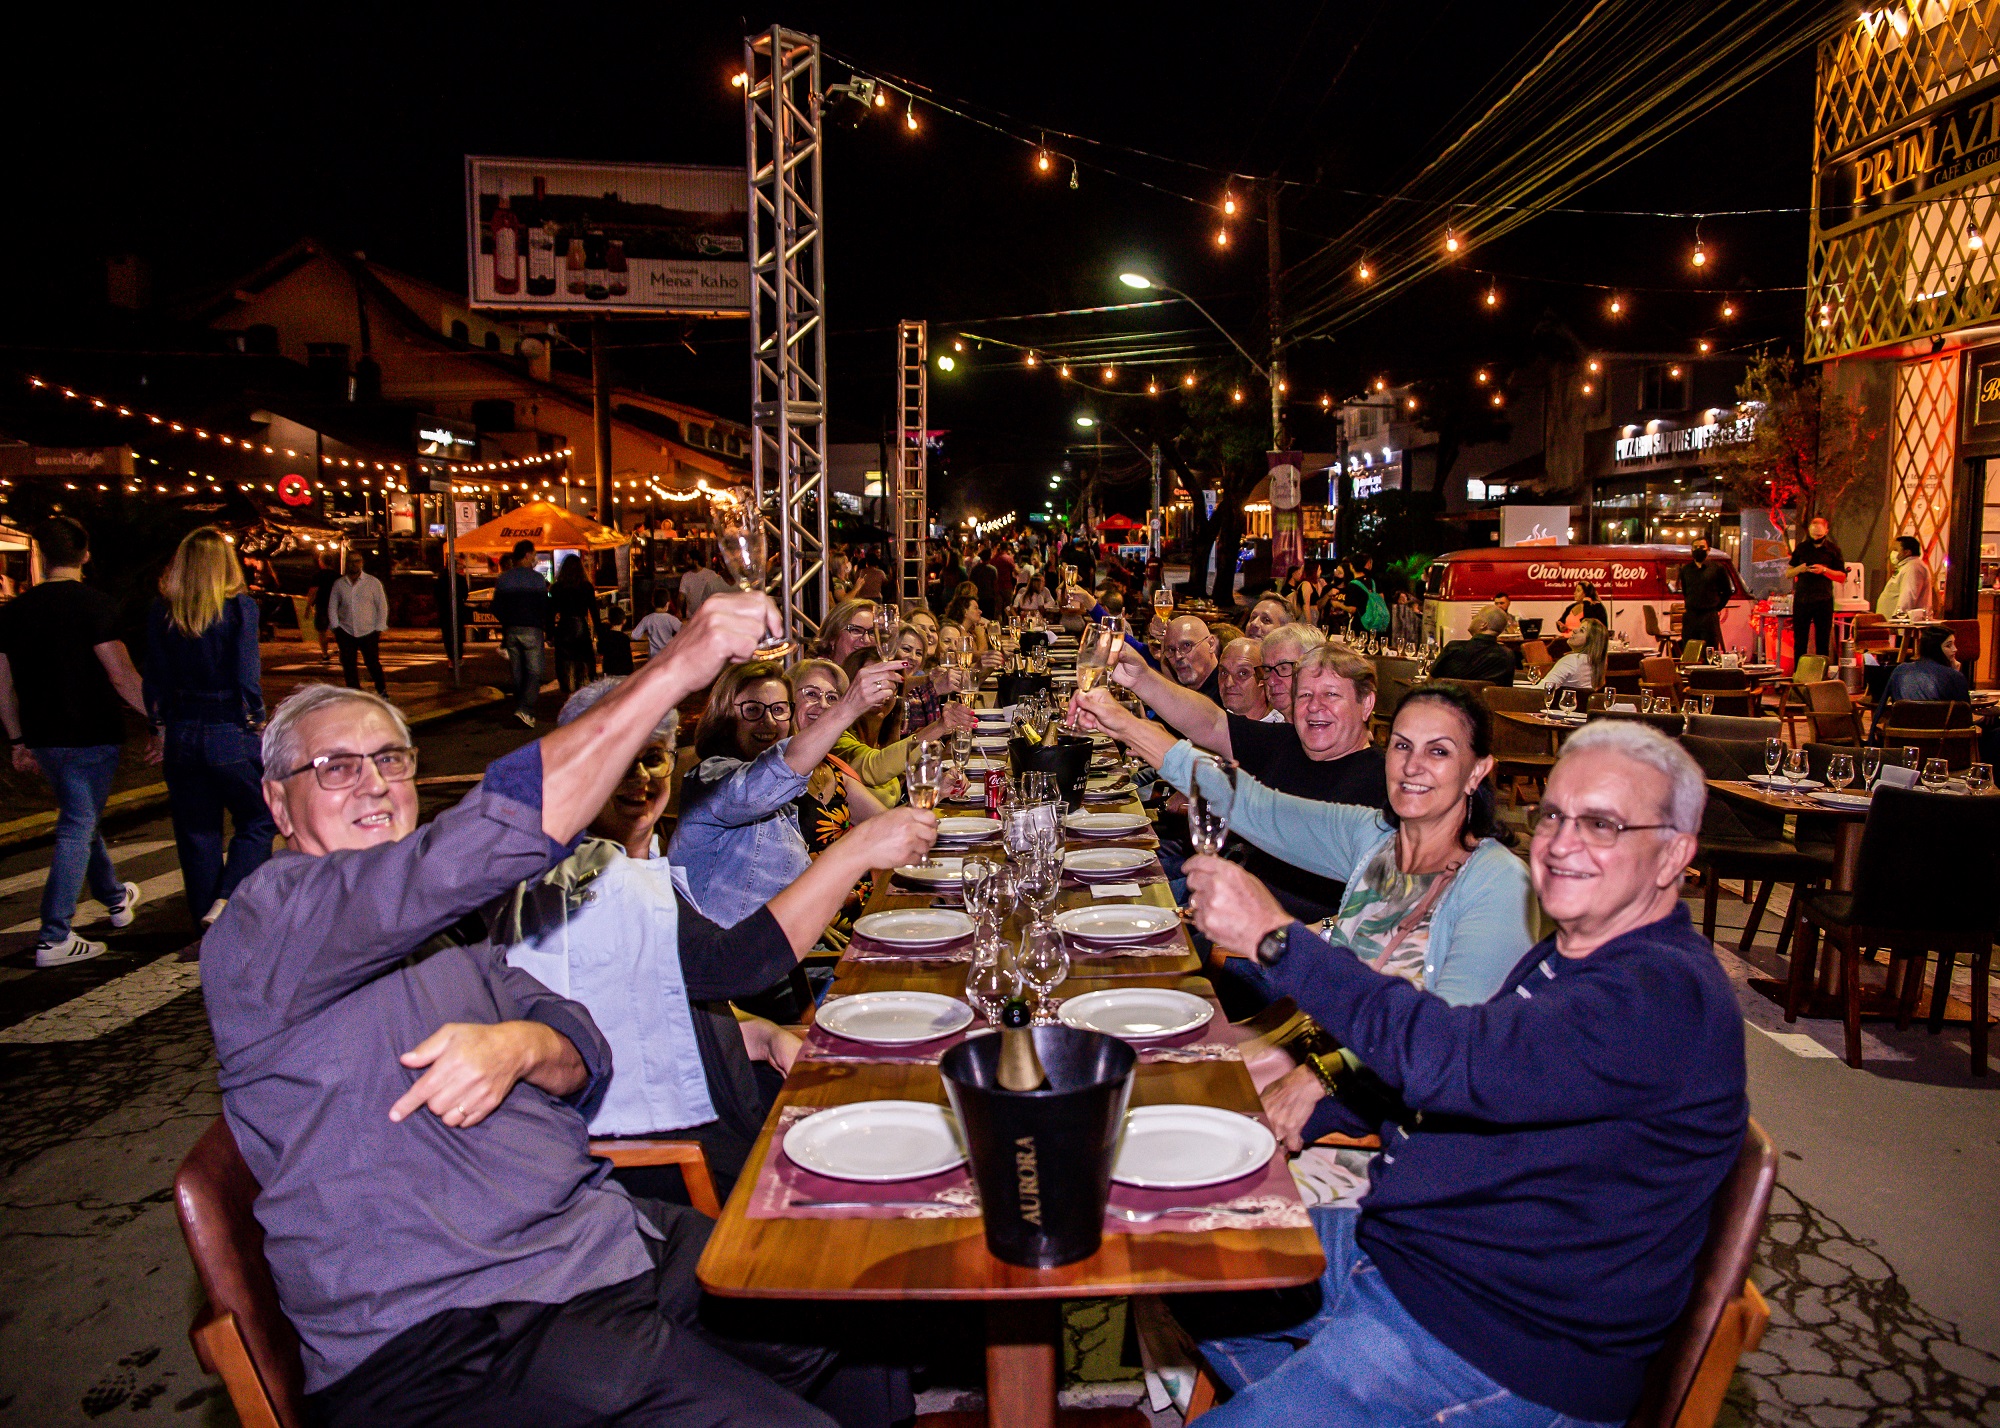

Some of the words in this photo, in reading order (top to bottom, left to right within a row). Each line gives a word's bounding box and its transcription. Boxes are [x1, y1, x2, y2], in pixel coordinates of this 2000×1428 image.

[1934, 161, 1962, 186] CAFÉ
[1964, 158, 1973, 173] &
[650, 271, 691, 287] Mena
[700, 273, 739, 288] Kaho
[1981, 377, 2000, 402] B
[463, 506, 470, 519] E
[1527, 563, 1607, 580] Charmosa
[1611, 563, 1648, 580] Beer
[1015, 1136, 1042, 1226] AURORA
